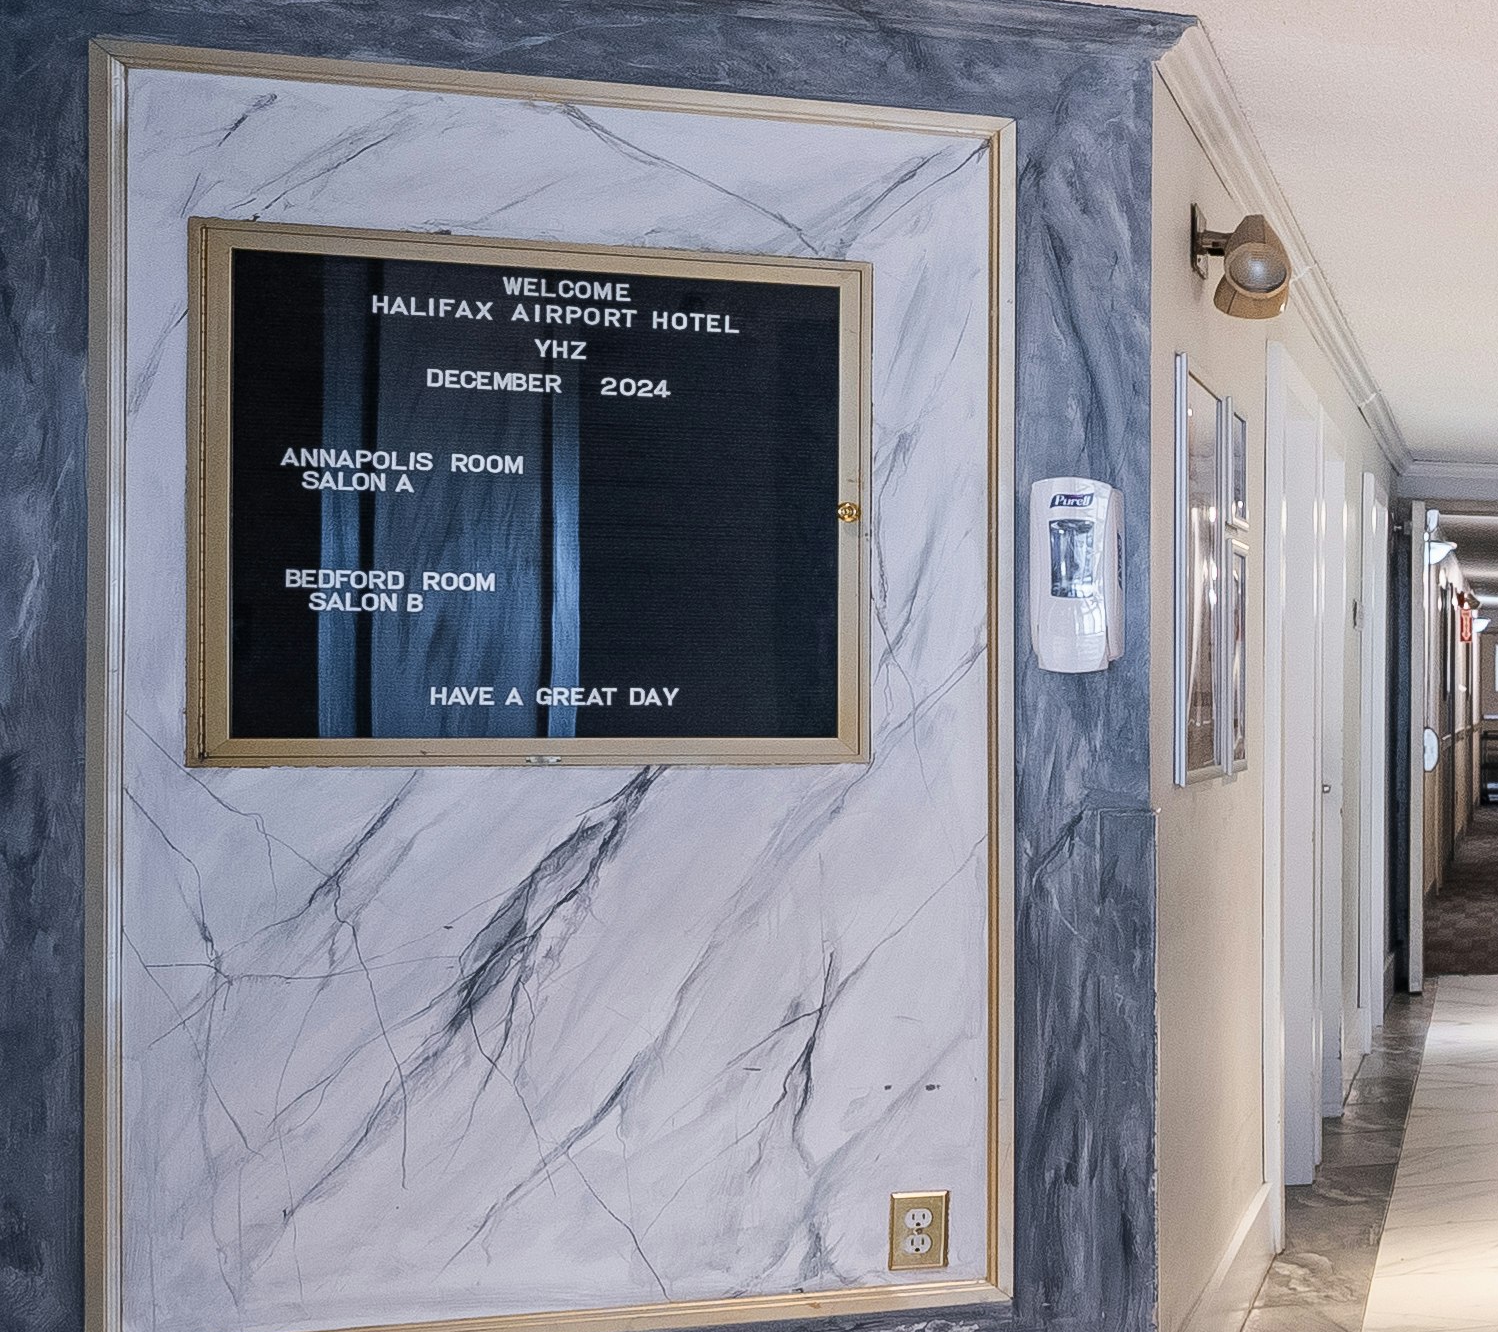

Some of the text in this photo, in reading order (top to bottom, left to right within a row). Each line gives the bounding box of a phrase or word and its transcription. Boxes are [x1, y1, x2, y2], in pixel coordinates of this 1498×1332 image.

[502, 276, 632, 302] WELCOME
[371, 294, 741, 334] HALIFAX AIRPORT HOTEL
[534, 338, 588, 361] YHZ
[426, 368, 671, 398] DECEMBER 2024
[280, 447, 525, 474] ANNAPOLIS ROOM
[301, 471, 415, 493] SALON A
[1054, 494, 1091, 507] Purell
[285, 568, 496, 592] BEDFORD ROOM
[308, 592, 424, 612] SALON B
[430, 686, 680, 706] HAVE A GREAT DAY
